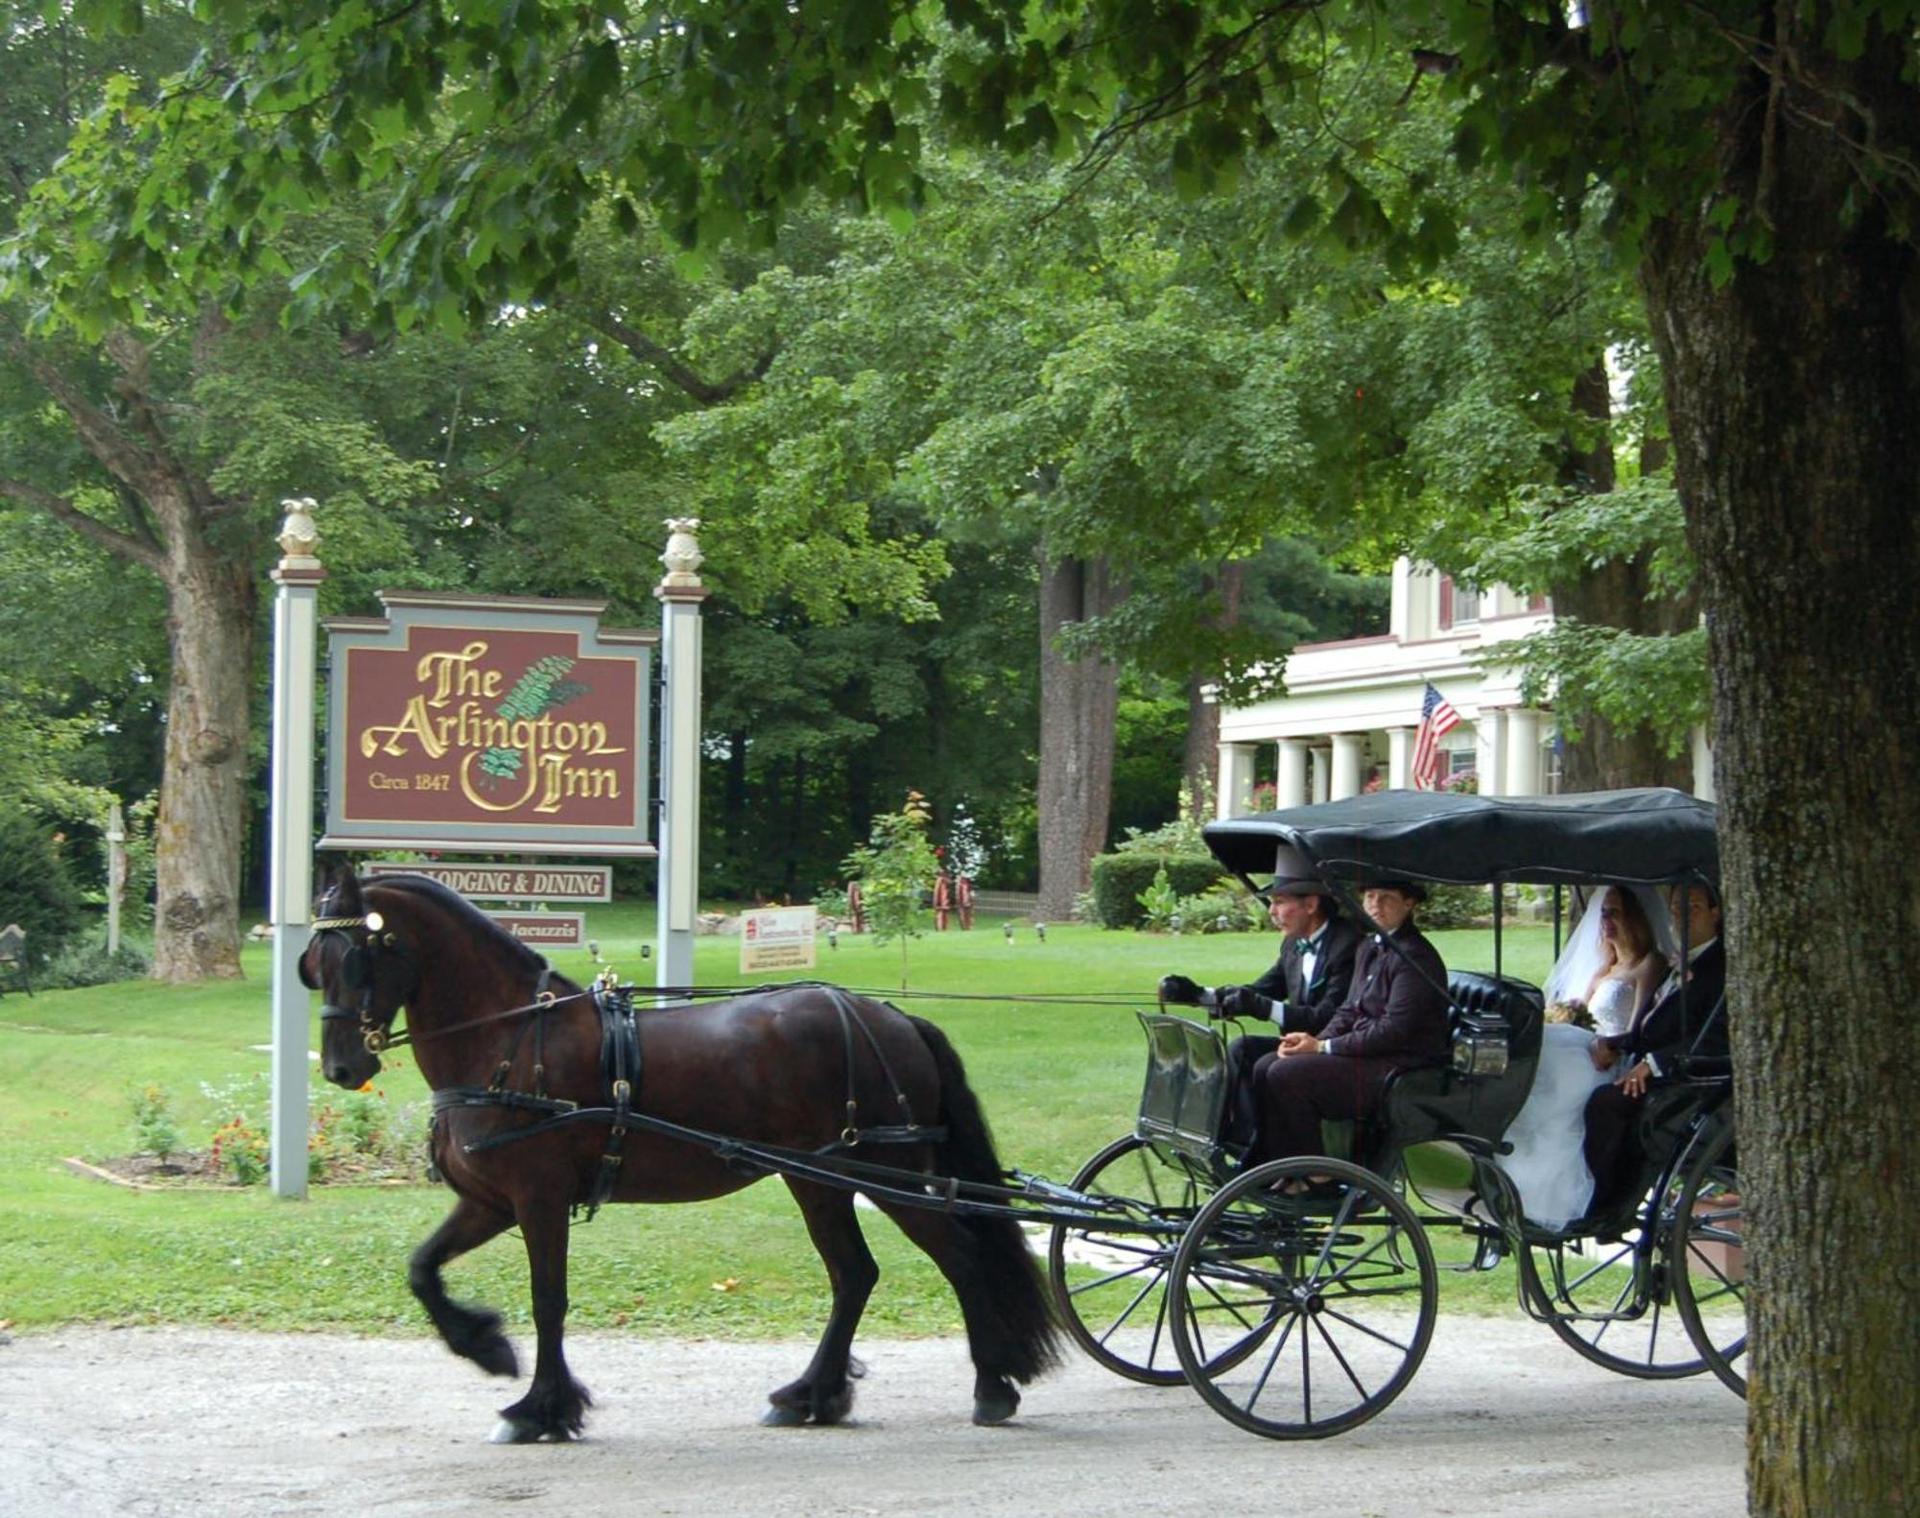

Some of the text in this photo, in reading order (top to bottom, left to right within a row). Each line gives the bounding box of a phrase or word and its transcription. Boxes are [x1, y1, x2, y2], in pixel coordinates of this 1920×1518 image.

[417, 641, 502, 708] The
[361, 695, 627, 811] Arlington
[368, 772, 450, 791] Circa 1847
[533, 752, 621, 813] Inn
[515, 874, 528, 893] &
[532, 874, 600, 895] DINING
[511, 923, 576, 937] Jacuzzis
